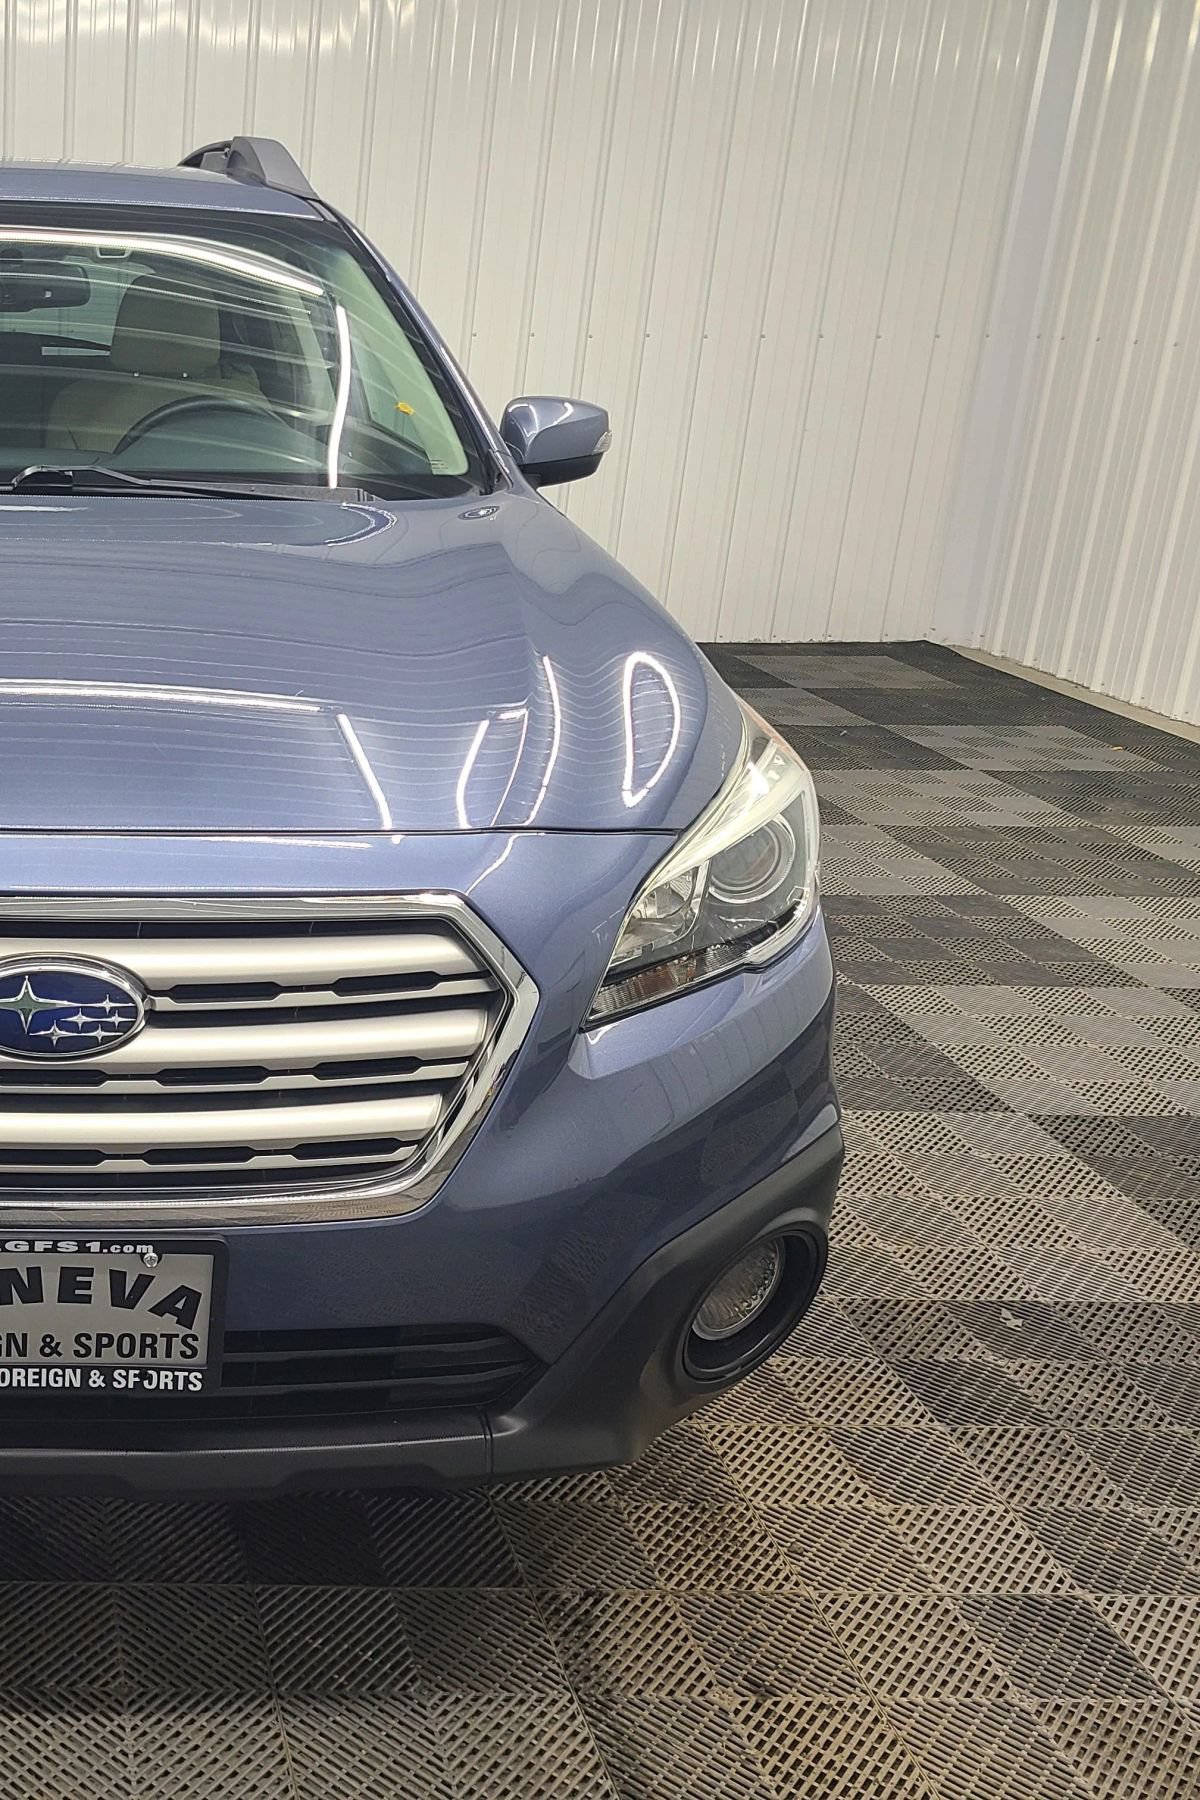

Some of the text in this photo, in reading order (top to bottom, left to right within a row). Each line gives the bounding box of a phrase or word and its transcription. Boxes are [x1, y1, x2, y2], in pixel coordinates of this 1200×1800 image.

[39, 1333, 63, 1358] &
[73, 1332, 199, 1360] SPORTS
[88, 1369, 106, 1388] &
